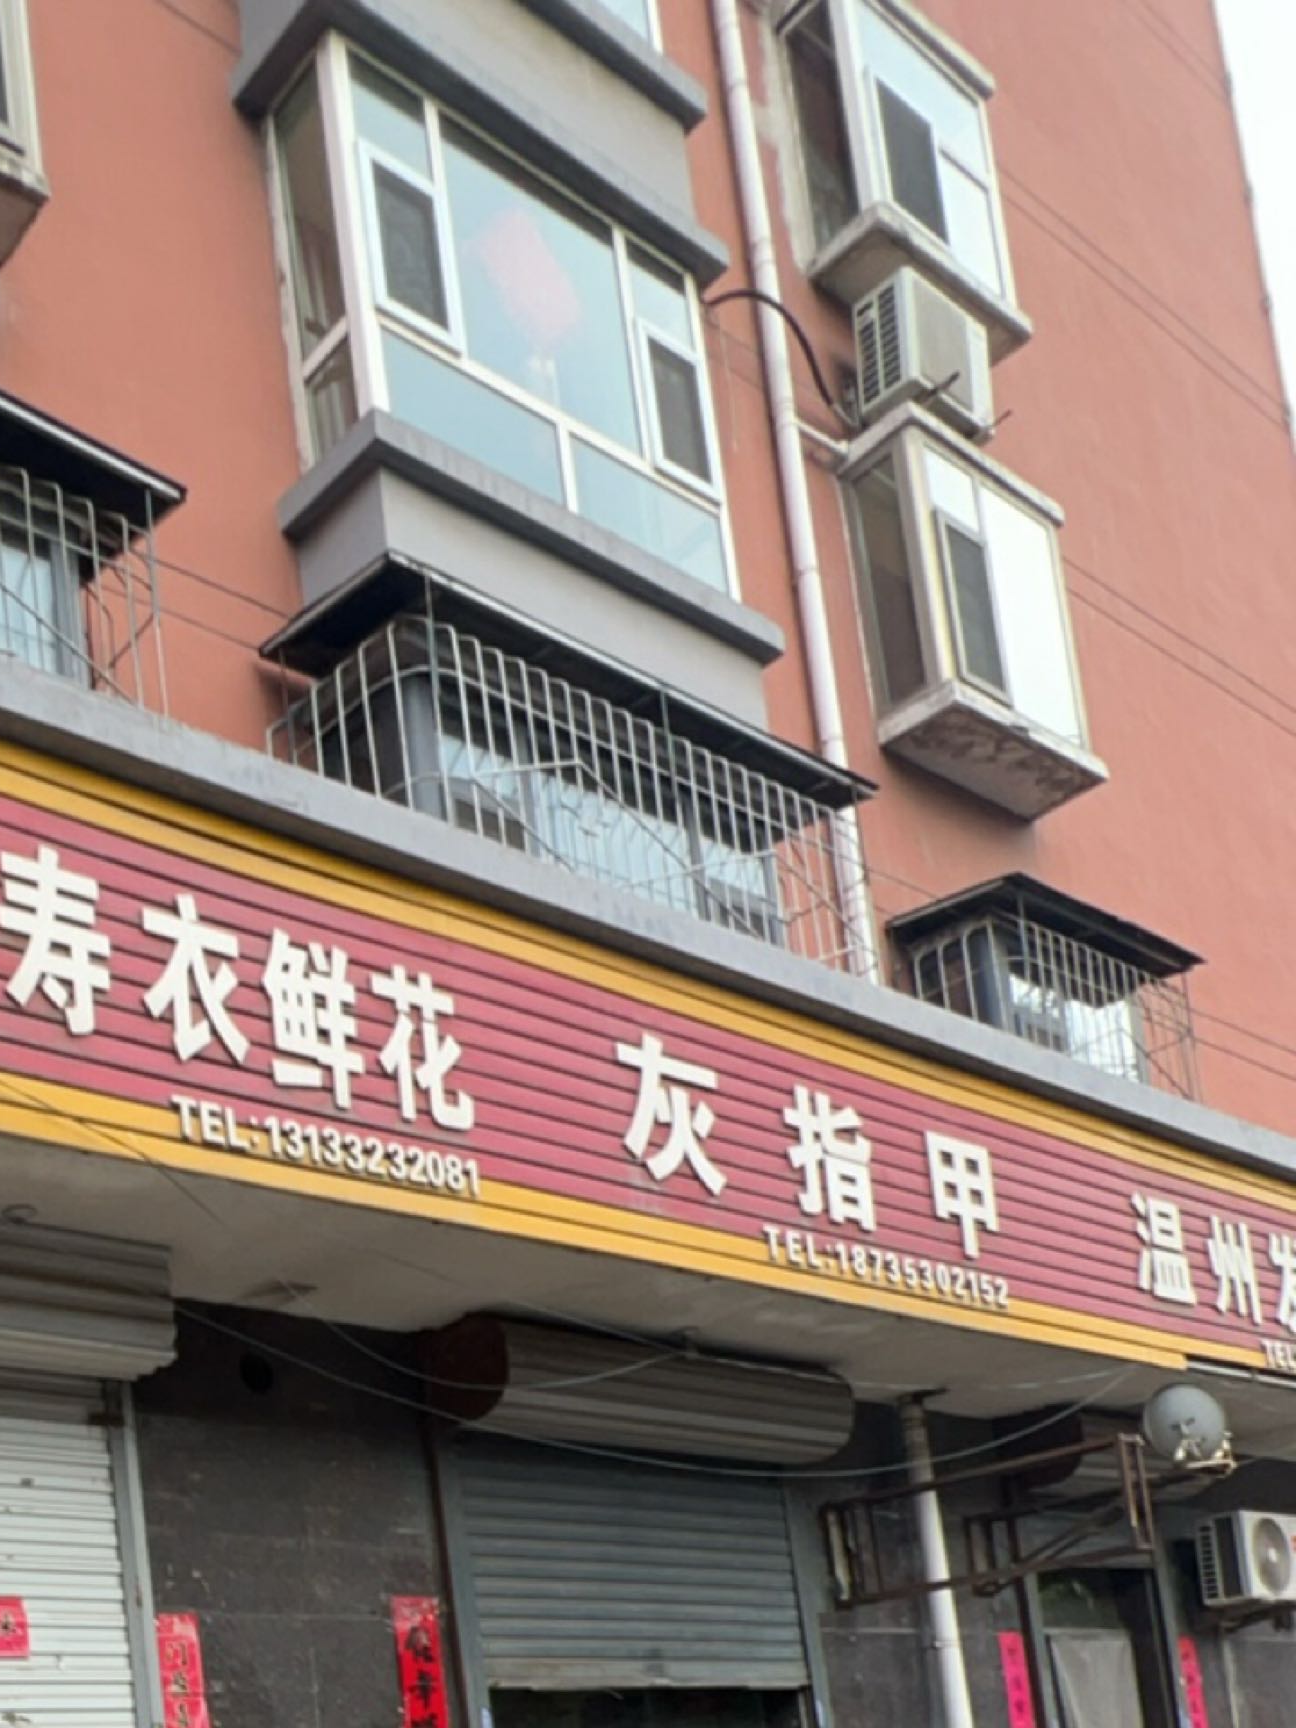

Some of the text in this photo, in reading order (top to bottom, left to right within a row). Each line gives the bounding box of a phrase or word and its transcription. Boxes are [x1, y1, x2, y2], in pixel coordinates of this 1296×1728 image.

[171, 1093, 481, 1200] TEL:13133232081
[614, 1032, 1002, 1259] 灰指甲
[762, 1223, 1010, 1310] TEL:18735302152
